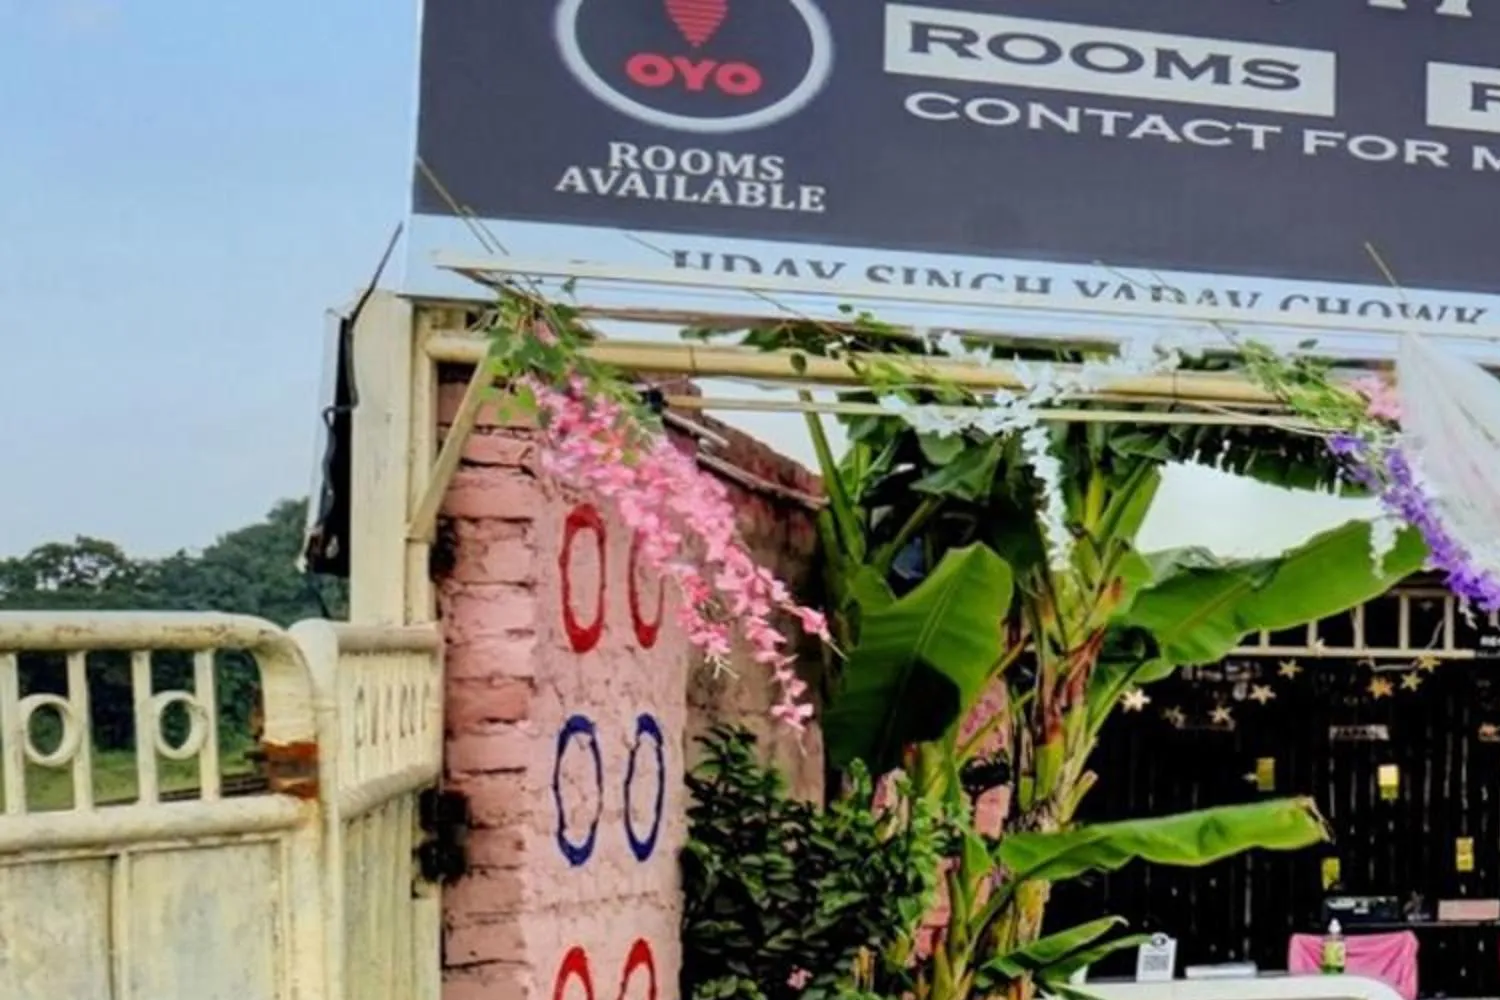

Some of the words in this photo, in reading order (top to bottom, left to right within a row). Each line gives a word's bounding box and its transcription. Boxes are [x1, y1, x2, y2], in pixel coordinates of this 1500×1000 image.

[624, 52, 763, 96] OYO
[907, 20, 1302, 92] ROOMS
[904, 91, 1282, 150] CONTACT
[1302, 130, 1450, 168] FOR
[608, 141, 785, 182] ROOMS
[554, 165, 827, 214] AVAILABLE
